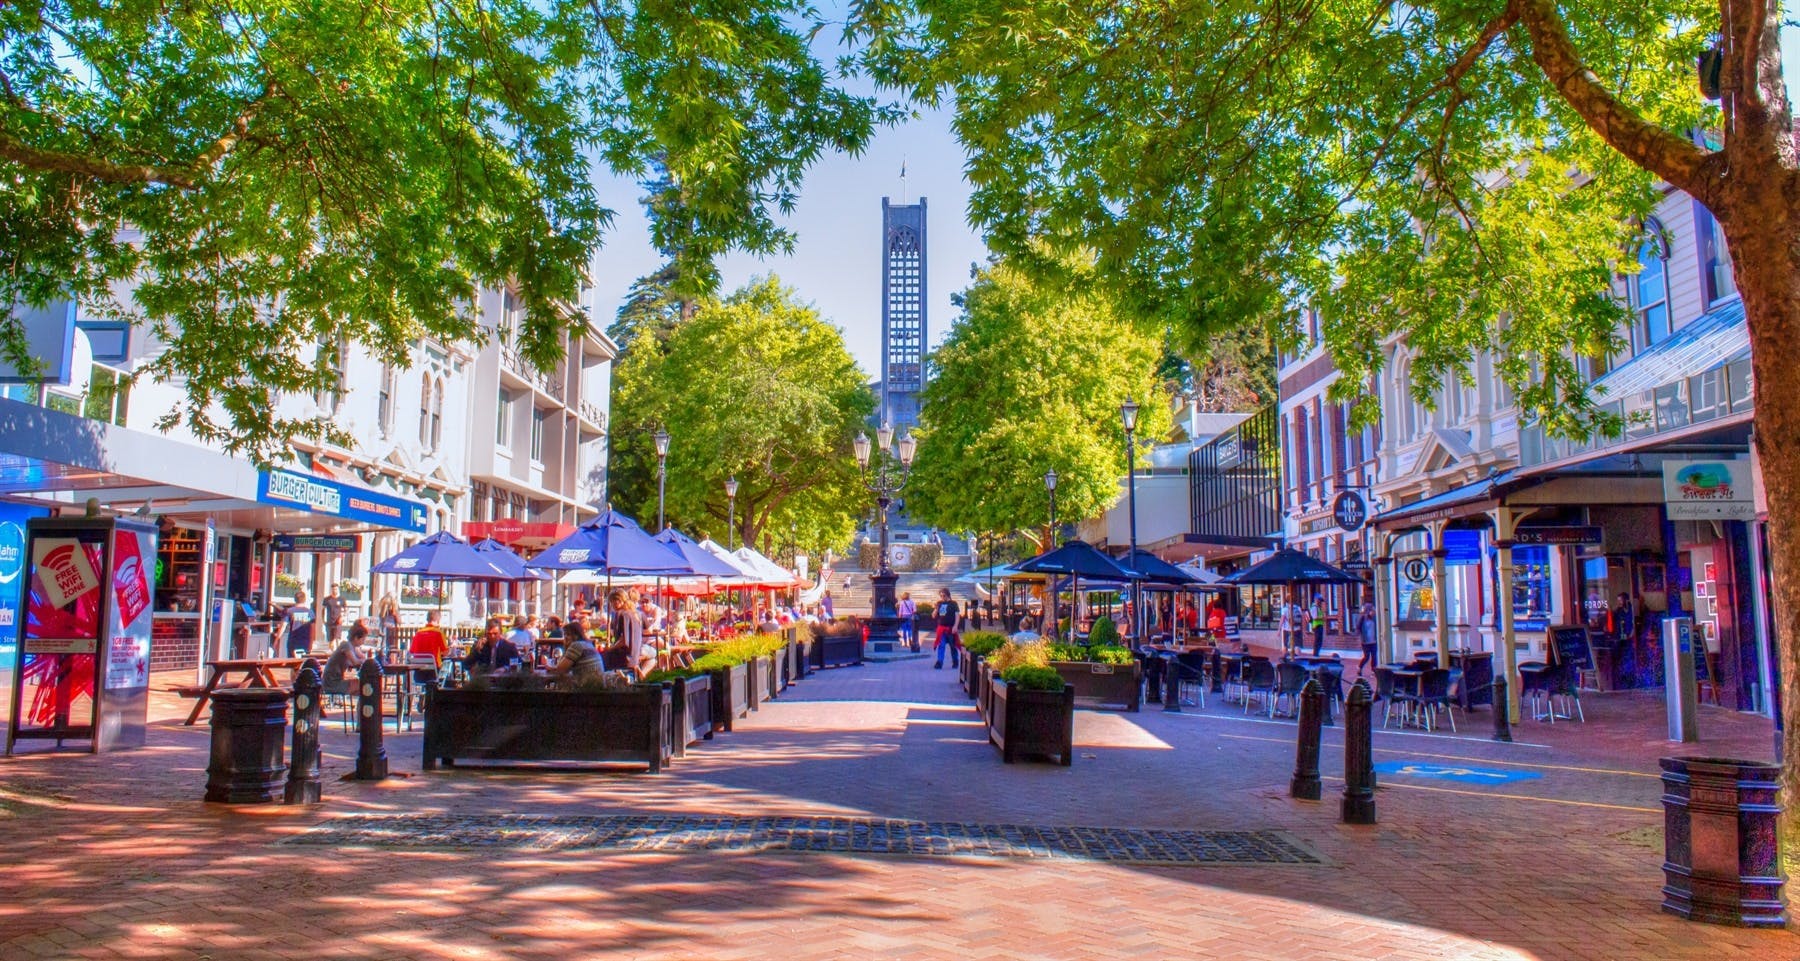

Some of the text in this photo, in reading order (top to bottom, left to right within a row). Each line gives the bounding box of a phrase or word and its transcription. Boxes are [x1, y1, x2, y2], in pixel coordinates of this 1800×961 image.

[270, 473, 339, 509] BURGER CULTURE
[294, 537, 323, 547] BURGER
[324, 539, 354, 548] CULTURE
[55, 564, 79, 582] FREE
[1411, 563, 1421, 578] U
[63, 581, 86, 599] ZONE
[124, 578, 140, 597] FREE
[1584, 600, 1609, 609] FORD'S
[1680, 626, 1689, 637] P
